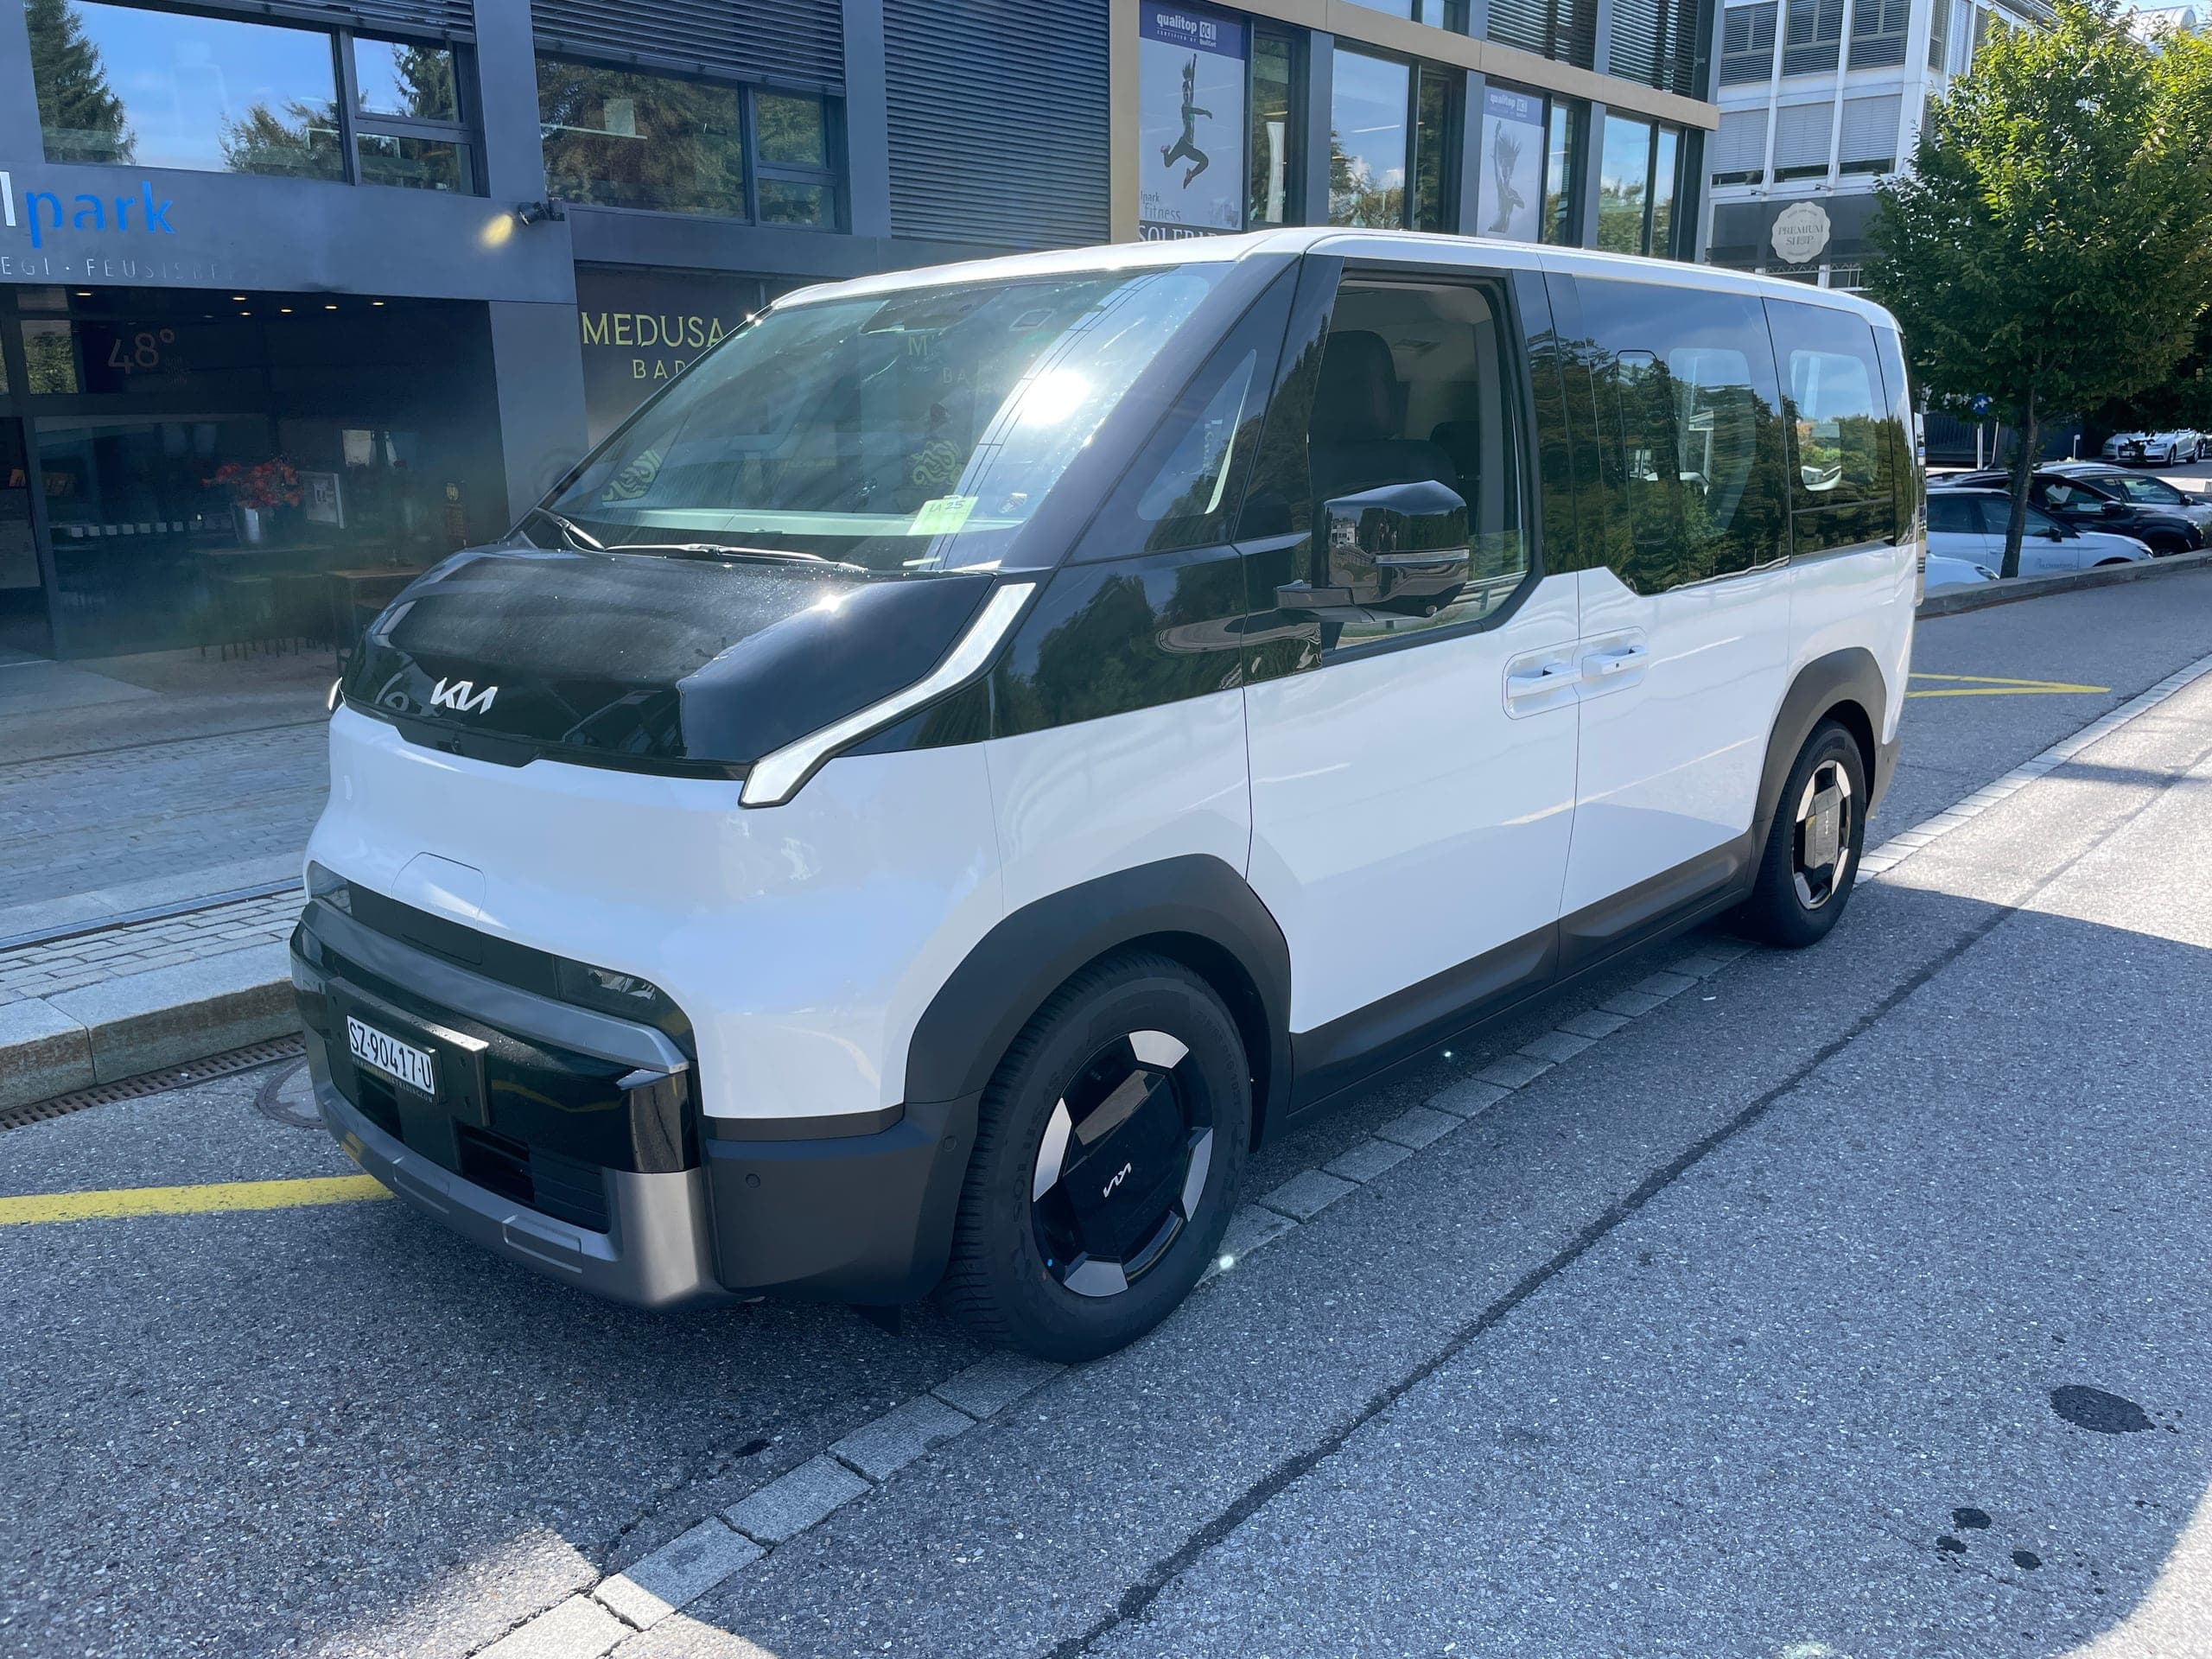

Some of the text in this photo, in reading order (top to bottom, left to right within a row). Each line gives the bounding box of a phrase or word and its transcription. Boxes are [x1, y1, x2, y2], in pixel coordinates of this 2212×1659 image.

[1156, 13, 1198, 35] qualitop
[1144, 202, 1181, 222] fitness
[581, 312, 724, 347] MEDUSA
[430, 677, 499, 715] KIA
